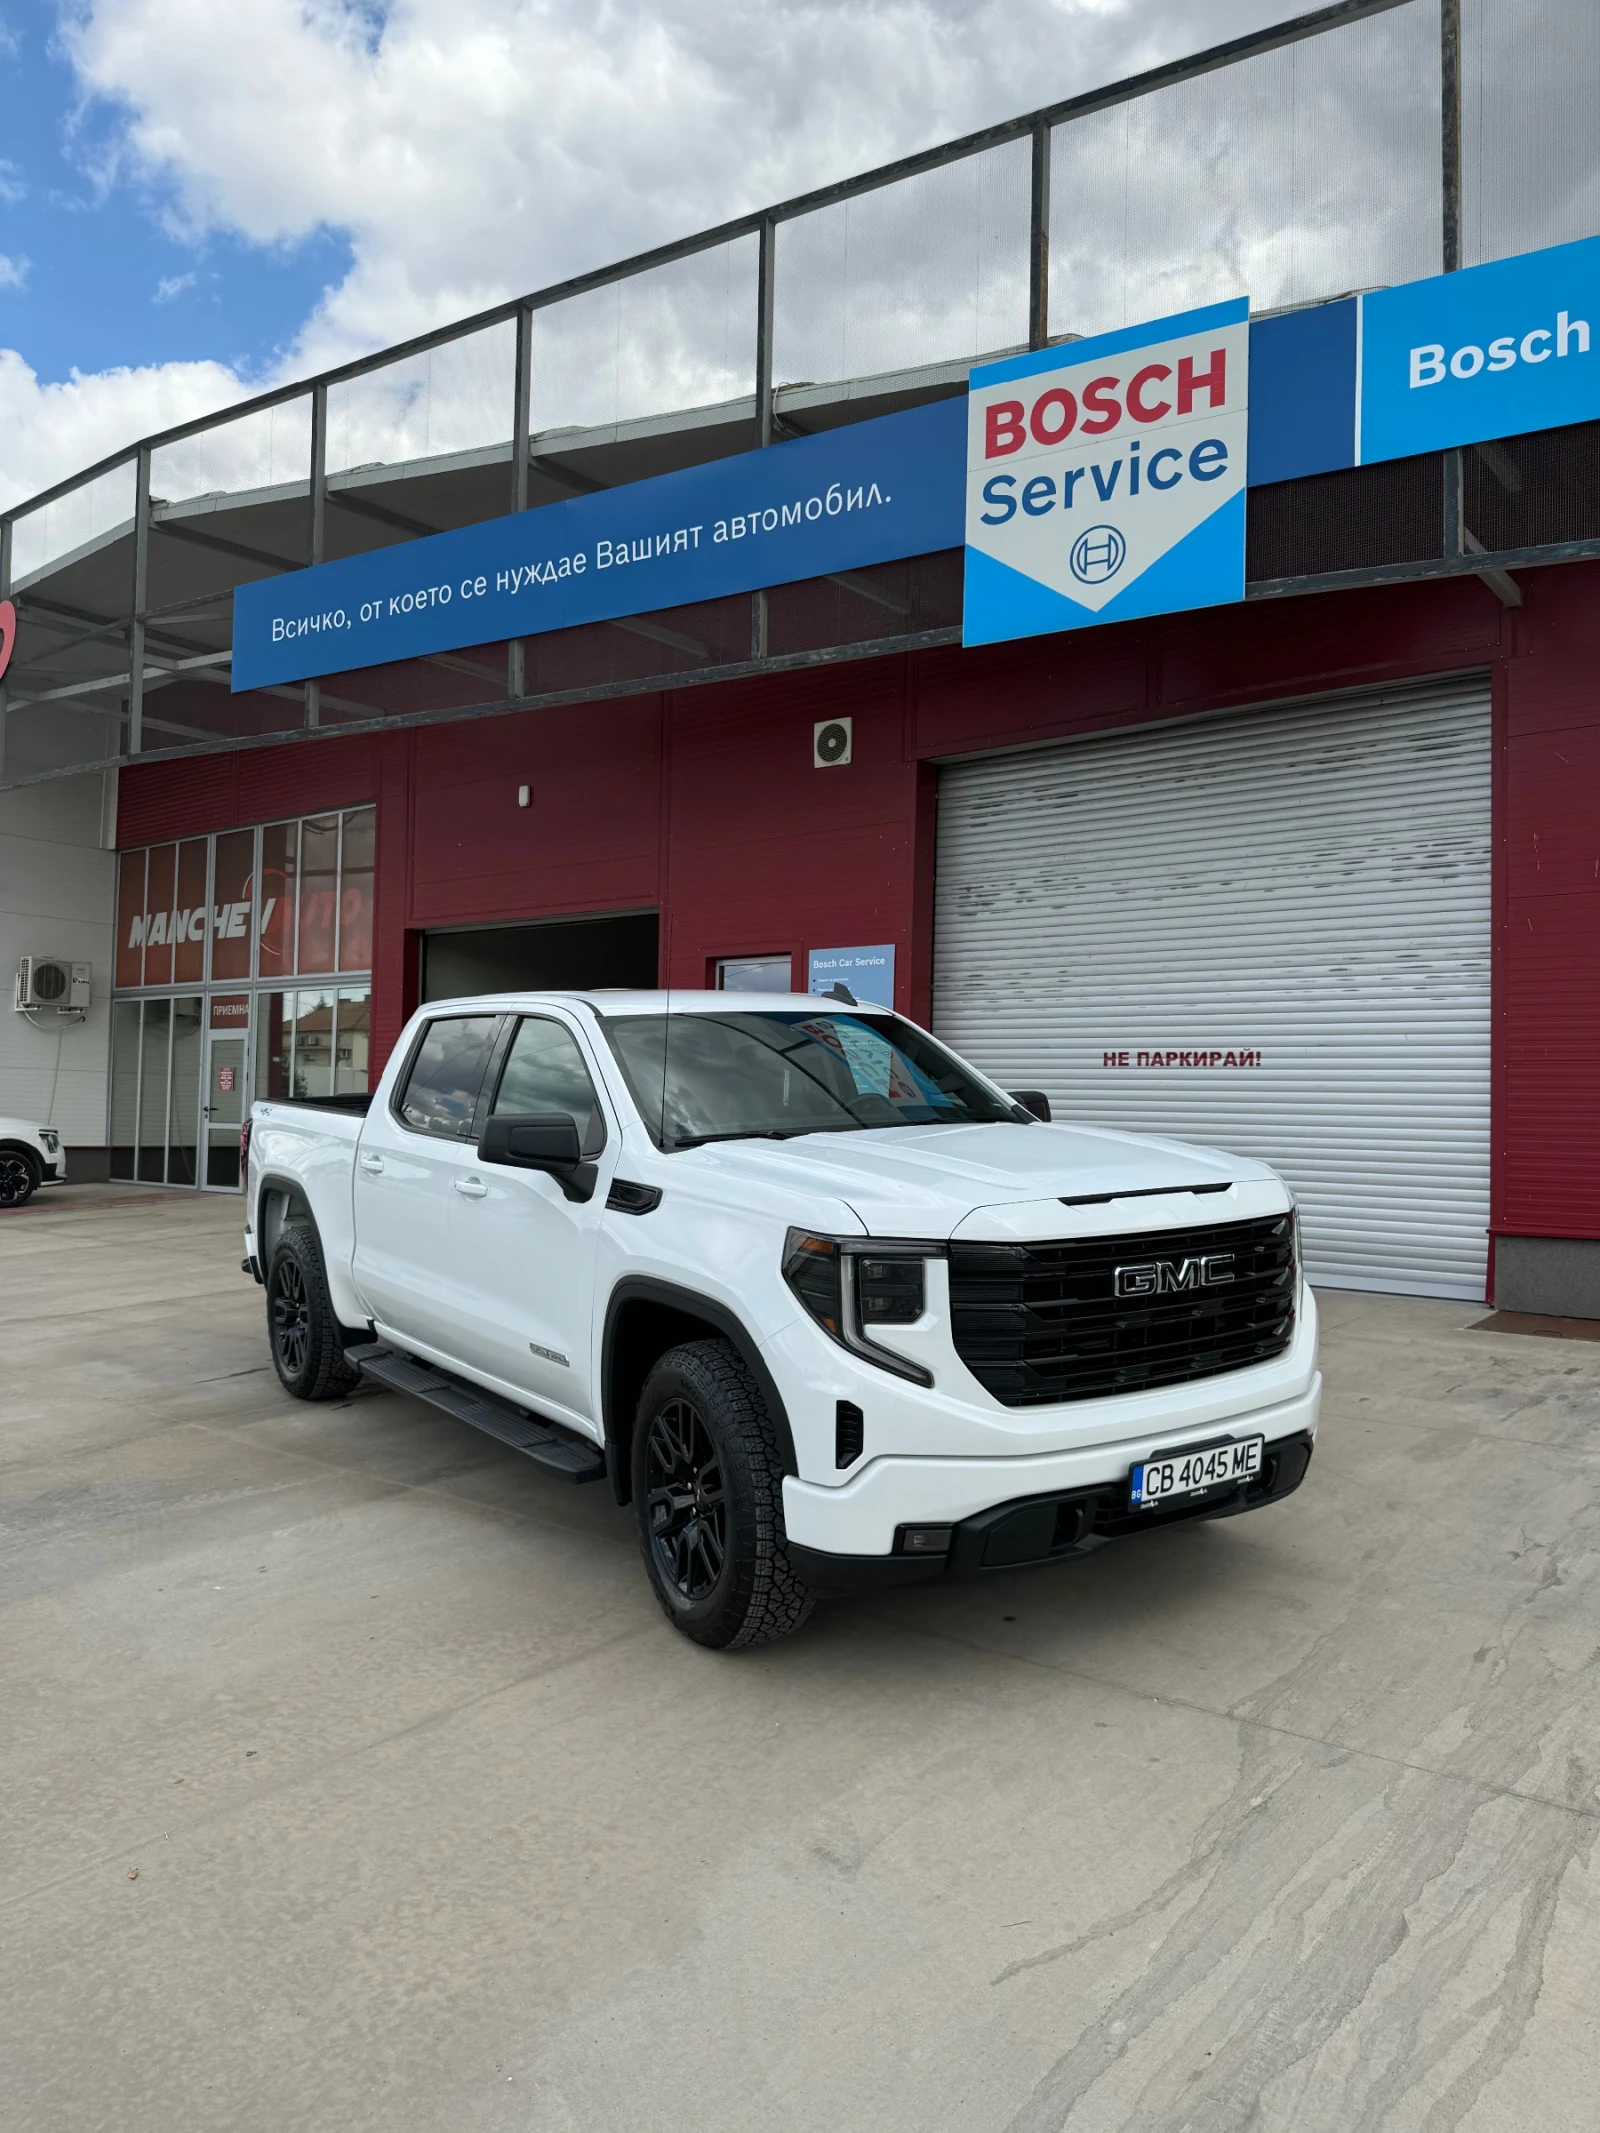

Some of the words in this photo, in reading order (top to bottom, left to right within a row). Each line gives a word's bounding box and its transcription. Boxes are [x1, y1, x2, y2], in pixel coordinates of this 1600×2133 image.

[1409, 310, 1590, 389] Bosch
[985, 349, 1226, 459] BOSCH
[980, 438, 1229, 526] Service
[271, 609, 352, 642] Всичко,
[360, 600, 383, 622] от
[389, 584, 453, 616] което
[460, 576, 488, 599] се
[496, 553, 588, 595] нуждае
[597, 525, 704, 570] Вашият
[713, 482, 893, 543] автомобил.
[813, 958, 837, 969] Bosch
[838, 958, 853, 968] Car
[855, 956, 886, 967] Service
[213, 1003, 249, 1016] ПРИЕМНА
[1103, 1051, 1130, 1067] НЕ
[1136, 1047, 1262, 1067] ПАРКИРАЙ!
[1114, 1253, 1235, 1298] GMC
[1145, 1463, 1174, 1496] CB
[1178, 1449, 1229, 1488] 4045
[1231, 1441, 1259, 1475] ME
[1131, 1489, 1142, 1500] BG
